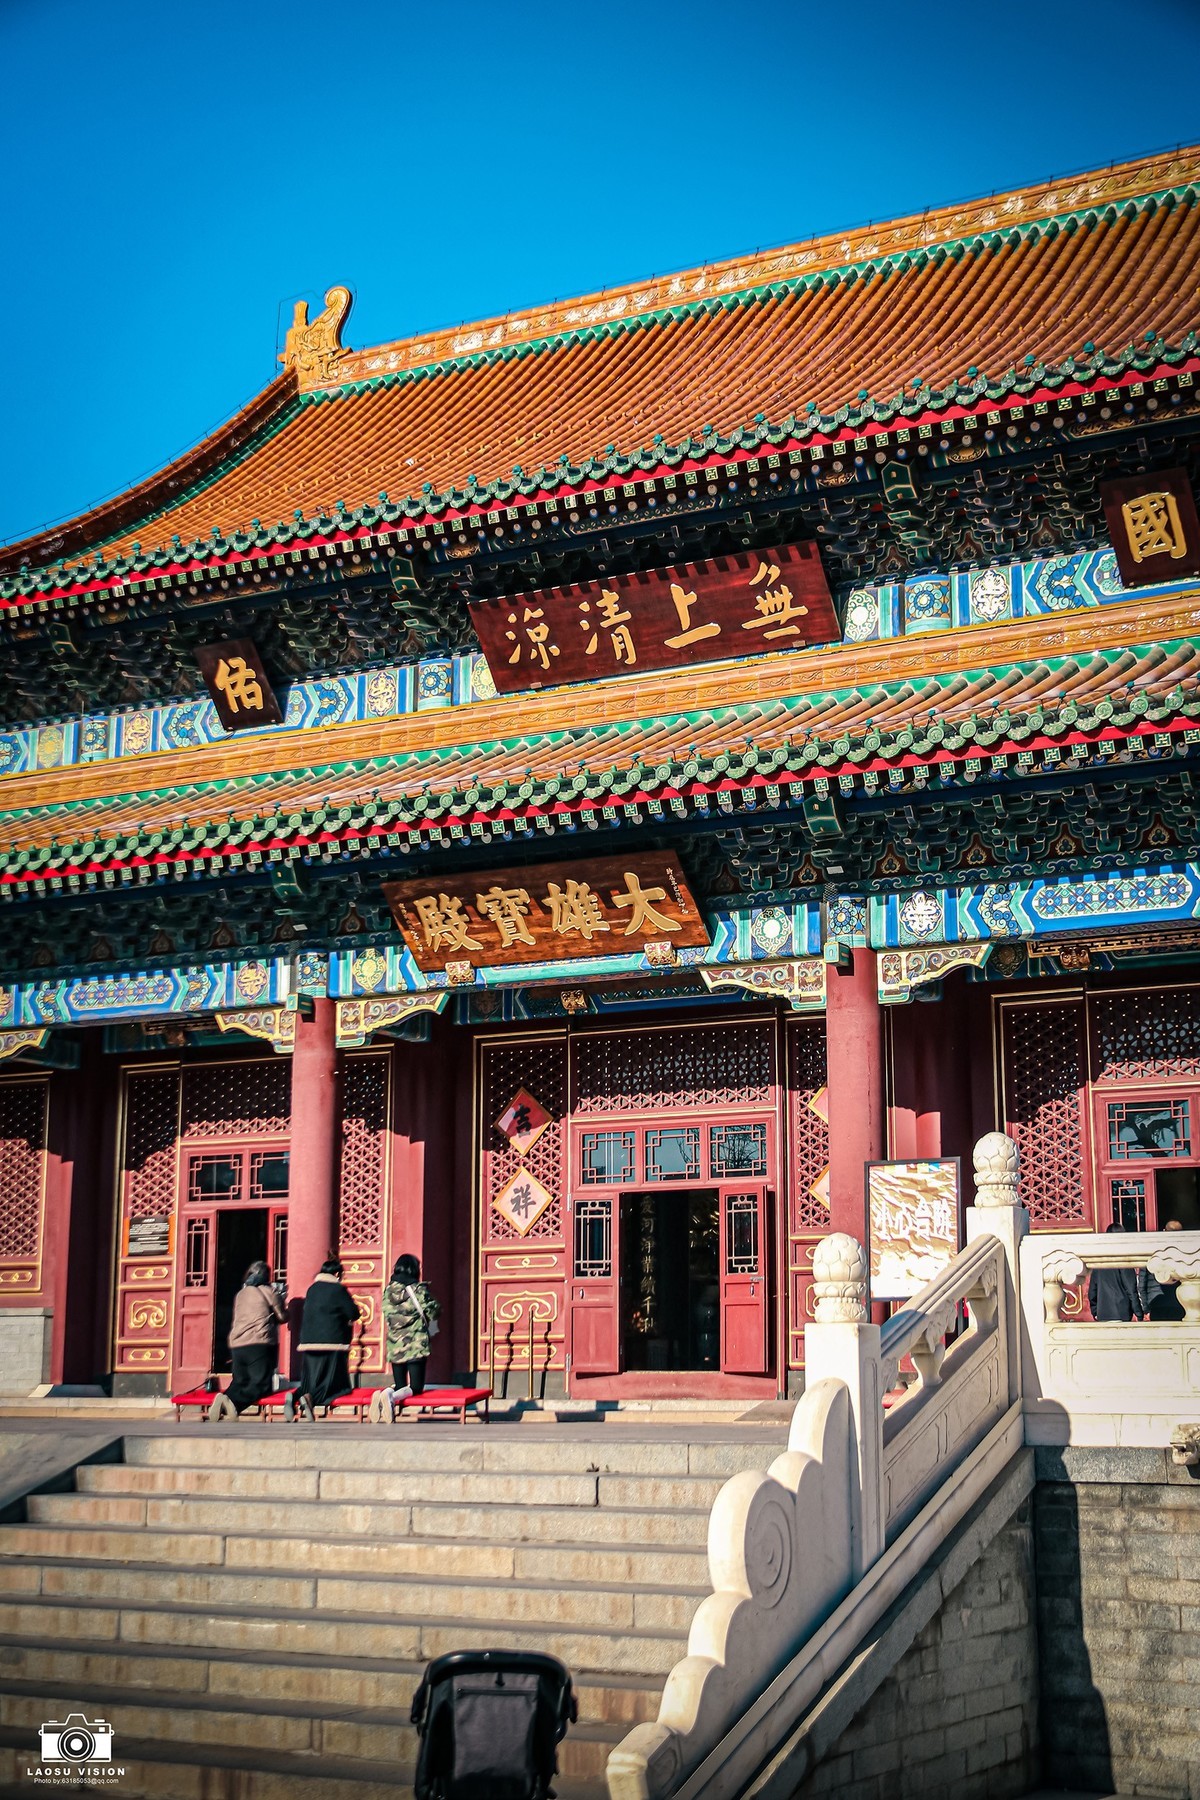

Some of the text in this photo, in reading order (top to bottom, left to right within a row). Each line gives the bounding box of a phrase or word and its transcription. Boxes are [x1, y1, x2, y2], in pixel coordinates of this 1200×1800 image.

[1121, 491, 1188, 564] 國
[214, 656, 264, 714] 佑
[413, 871, 683, 953] 大雄寶殿
[513, 1103, 532, 1138] 吉
[510, 1183, 537, 1219] 祥
